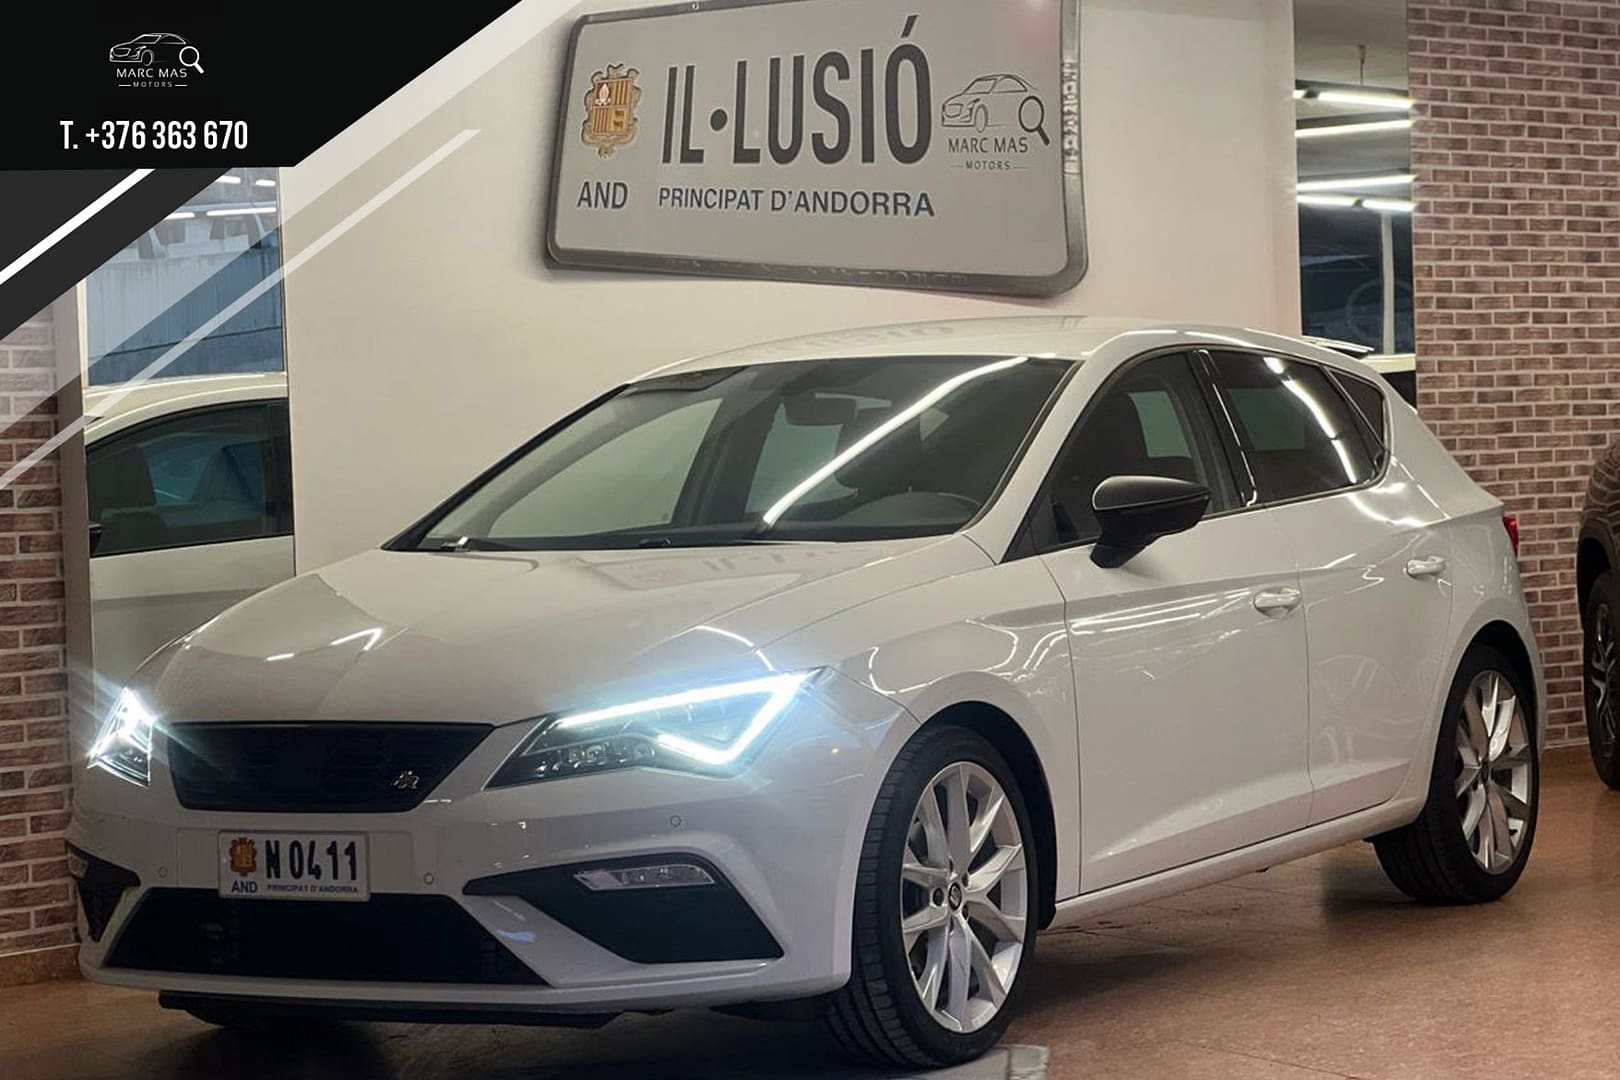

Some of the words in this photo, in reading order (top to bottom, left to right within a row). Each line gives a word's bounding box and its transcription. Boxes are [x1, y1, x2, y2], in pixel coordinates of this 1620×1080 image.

[948, 137, 989, 155] MARC
[993, 136, 1029, 154] MAS
[965, 160, 1011, 171] MOTORS
[576, 181, 629, 210] AND
[658, 187, 764, 211] PRINCIPAT
[770, 190, 935, 217] D'ANDORRA
[265, 840, 281, 879] N
[289, 840, 357, 881] 0411
[231, 881, 258, 894] AND
[267, 884, 308, 892] PRINCIPAT
